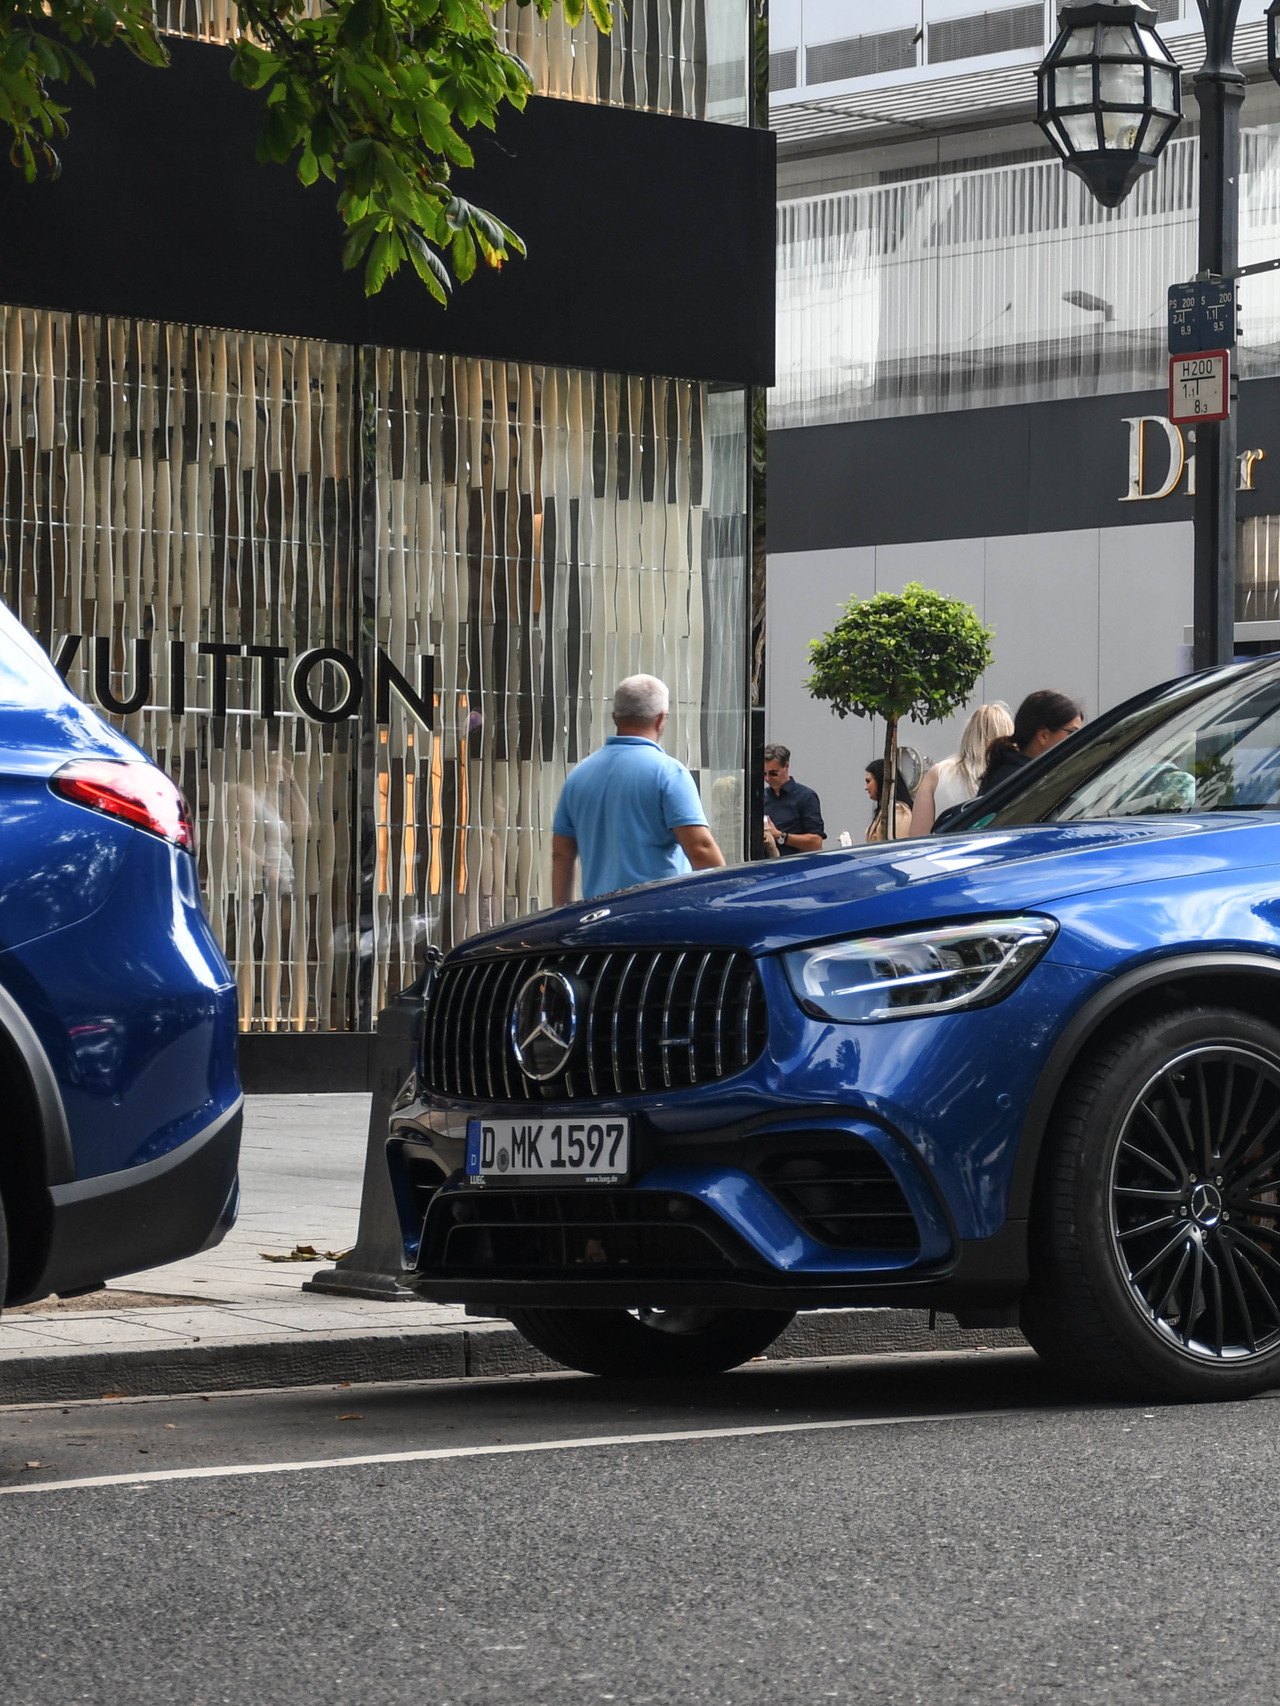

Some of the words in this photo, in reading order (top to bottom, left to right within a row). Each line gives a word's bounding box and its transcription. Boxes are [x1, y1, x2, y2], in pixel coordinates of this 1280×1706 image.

[1182, 297, 1195, 308] 200
[1201, 295, 1206, 305] S
[1219, 292, 1232, 303] 200
[1213, 321, 1224, 331] 9.5
[1182, 383, 1195, 398] 1.1
[1194, 399, 1208, 414] 8.3
[1118, 415, 1264, 501] Dir
[481, 1126, 496, 1168] D
[511, 1125, 543, 1168] MK
[550, 1124, 624, 1168] 1597
[470, 1154, 477, 1166] D
